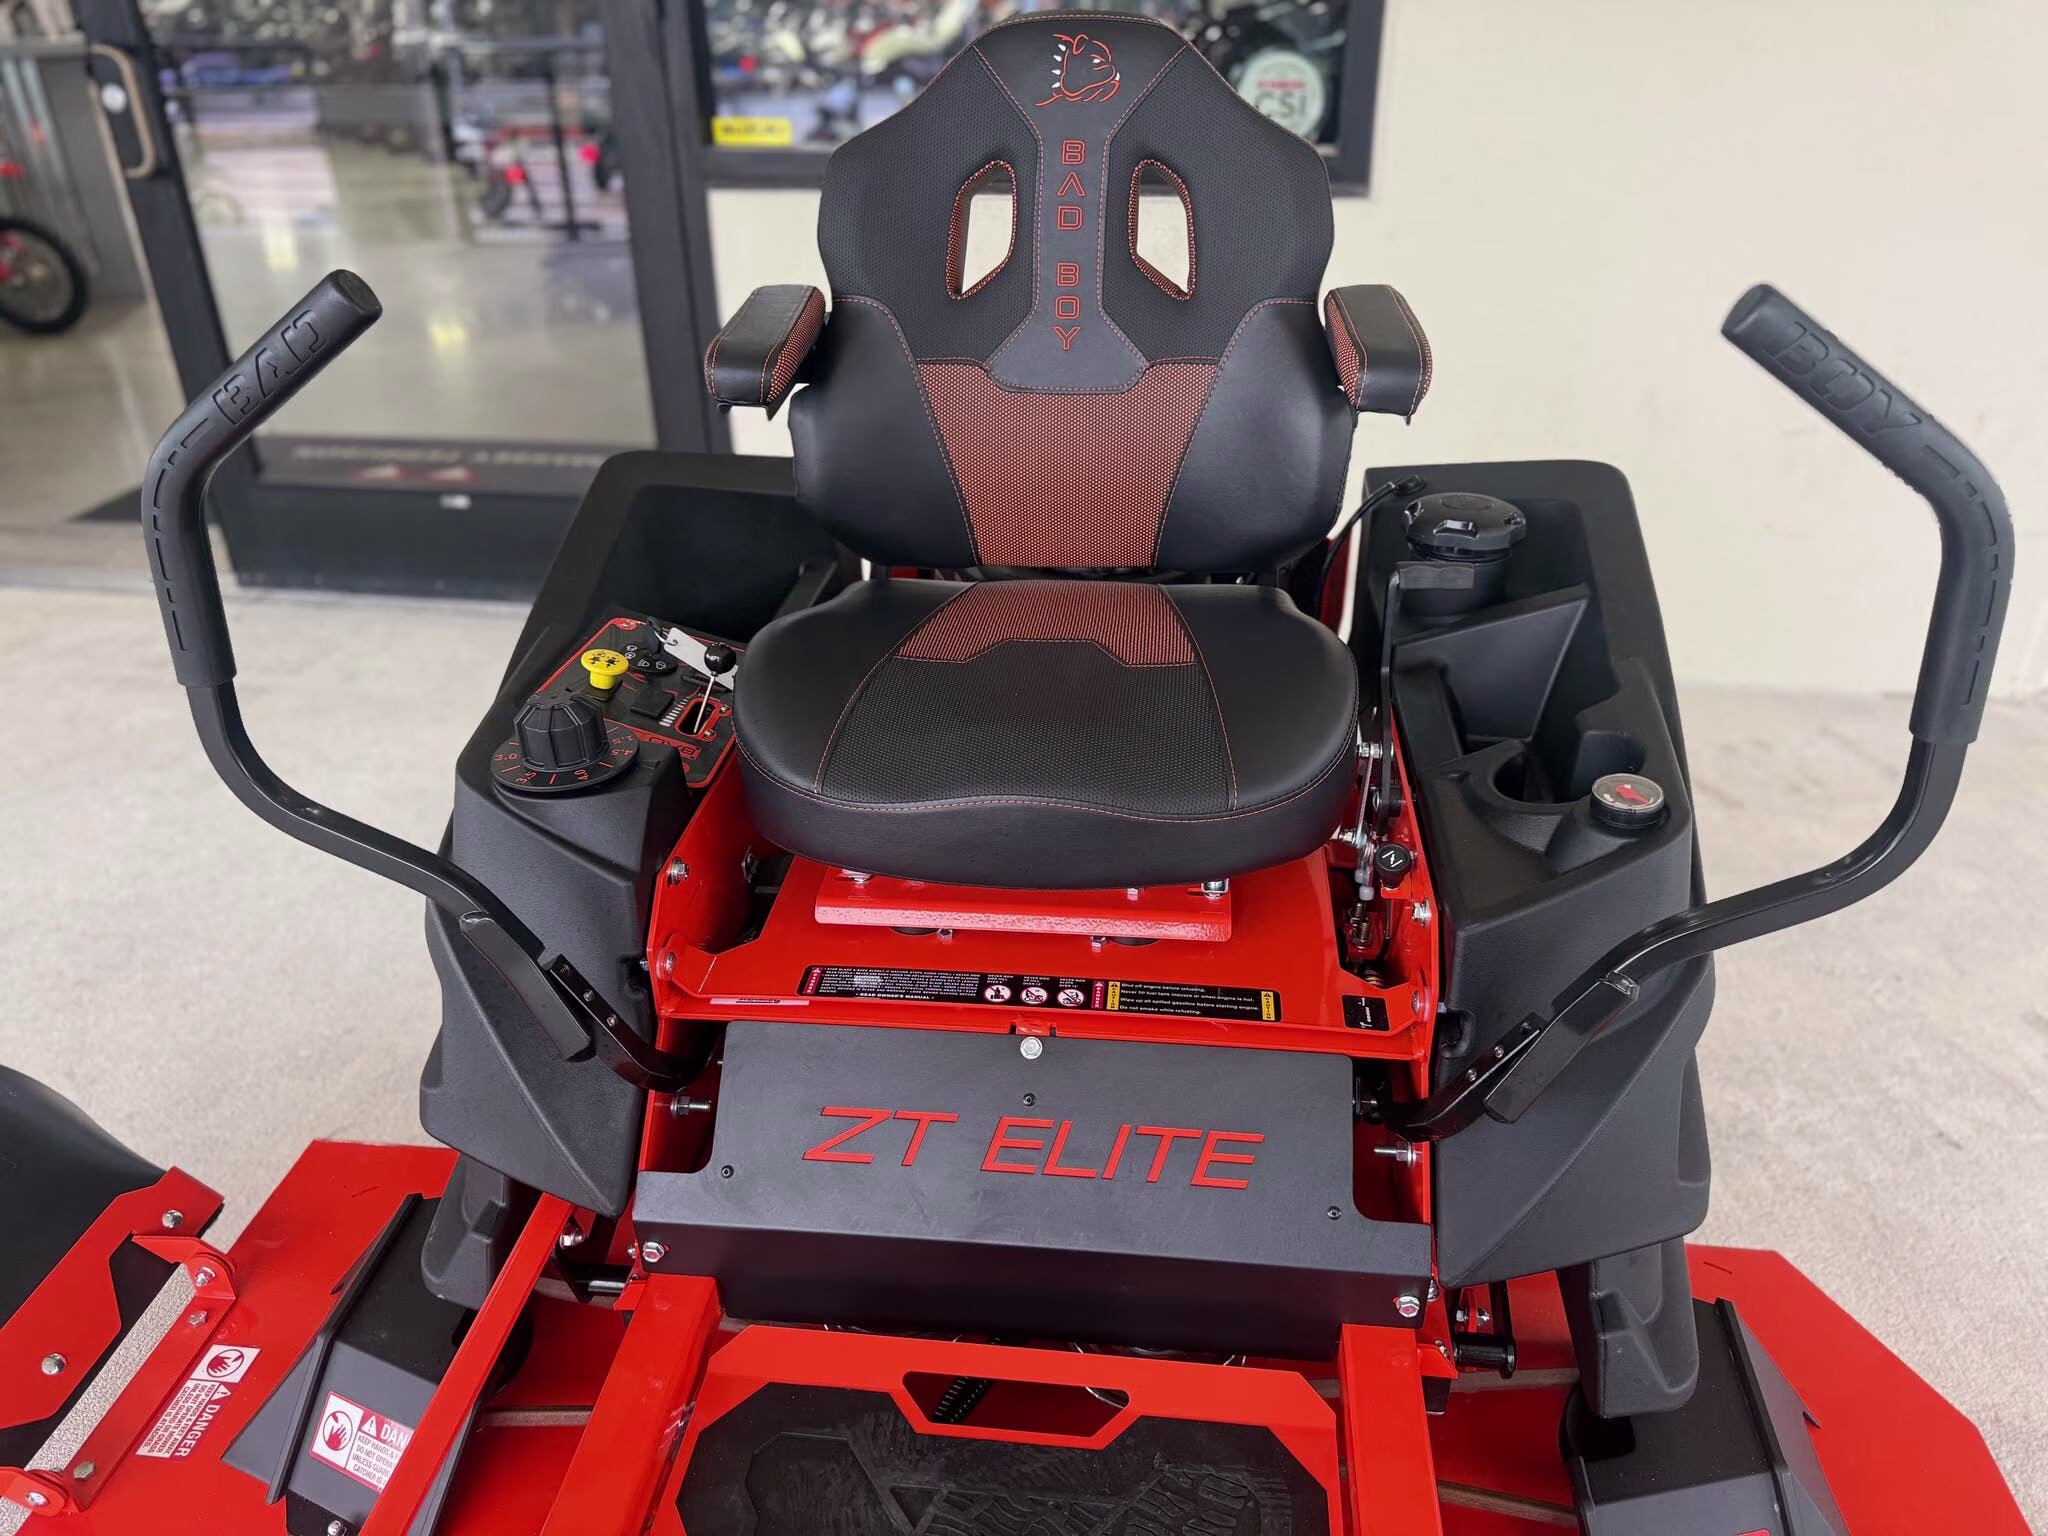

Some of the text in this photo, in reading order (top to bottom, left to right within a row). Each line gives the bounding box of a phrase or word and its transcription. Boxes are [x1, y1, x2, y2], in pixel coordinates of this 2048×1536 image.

[1052, 140, 1086, 350] BAD BOY
[212, 309, 329, 425] BAD
[1763, 321, 1922, 437] BOY
[495, 753, 519, 762] 3.0
[515, 771, 538, 784] 3.5
[802, 1105, 1265, 1190] ZT ELITE
[174, 1404, 221, 1457] DANGER
[381, 1423, 409, 1449] DAN
[352, 1463, 377, 1481] CATCHER
[372, 1463, 391, 1477] GUAR
